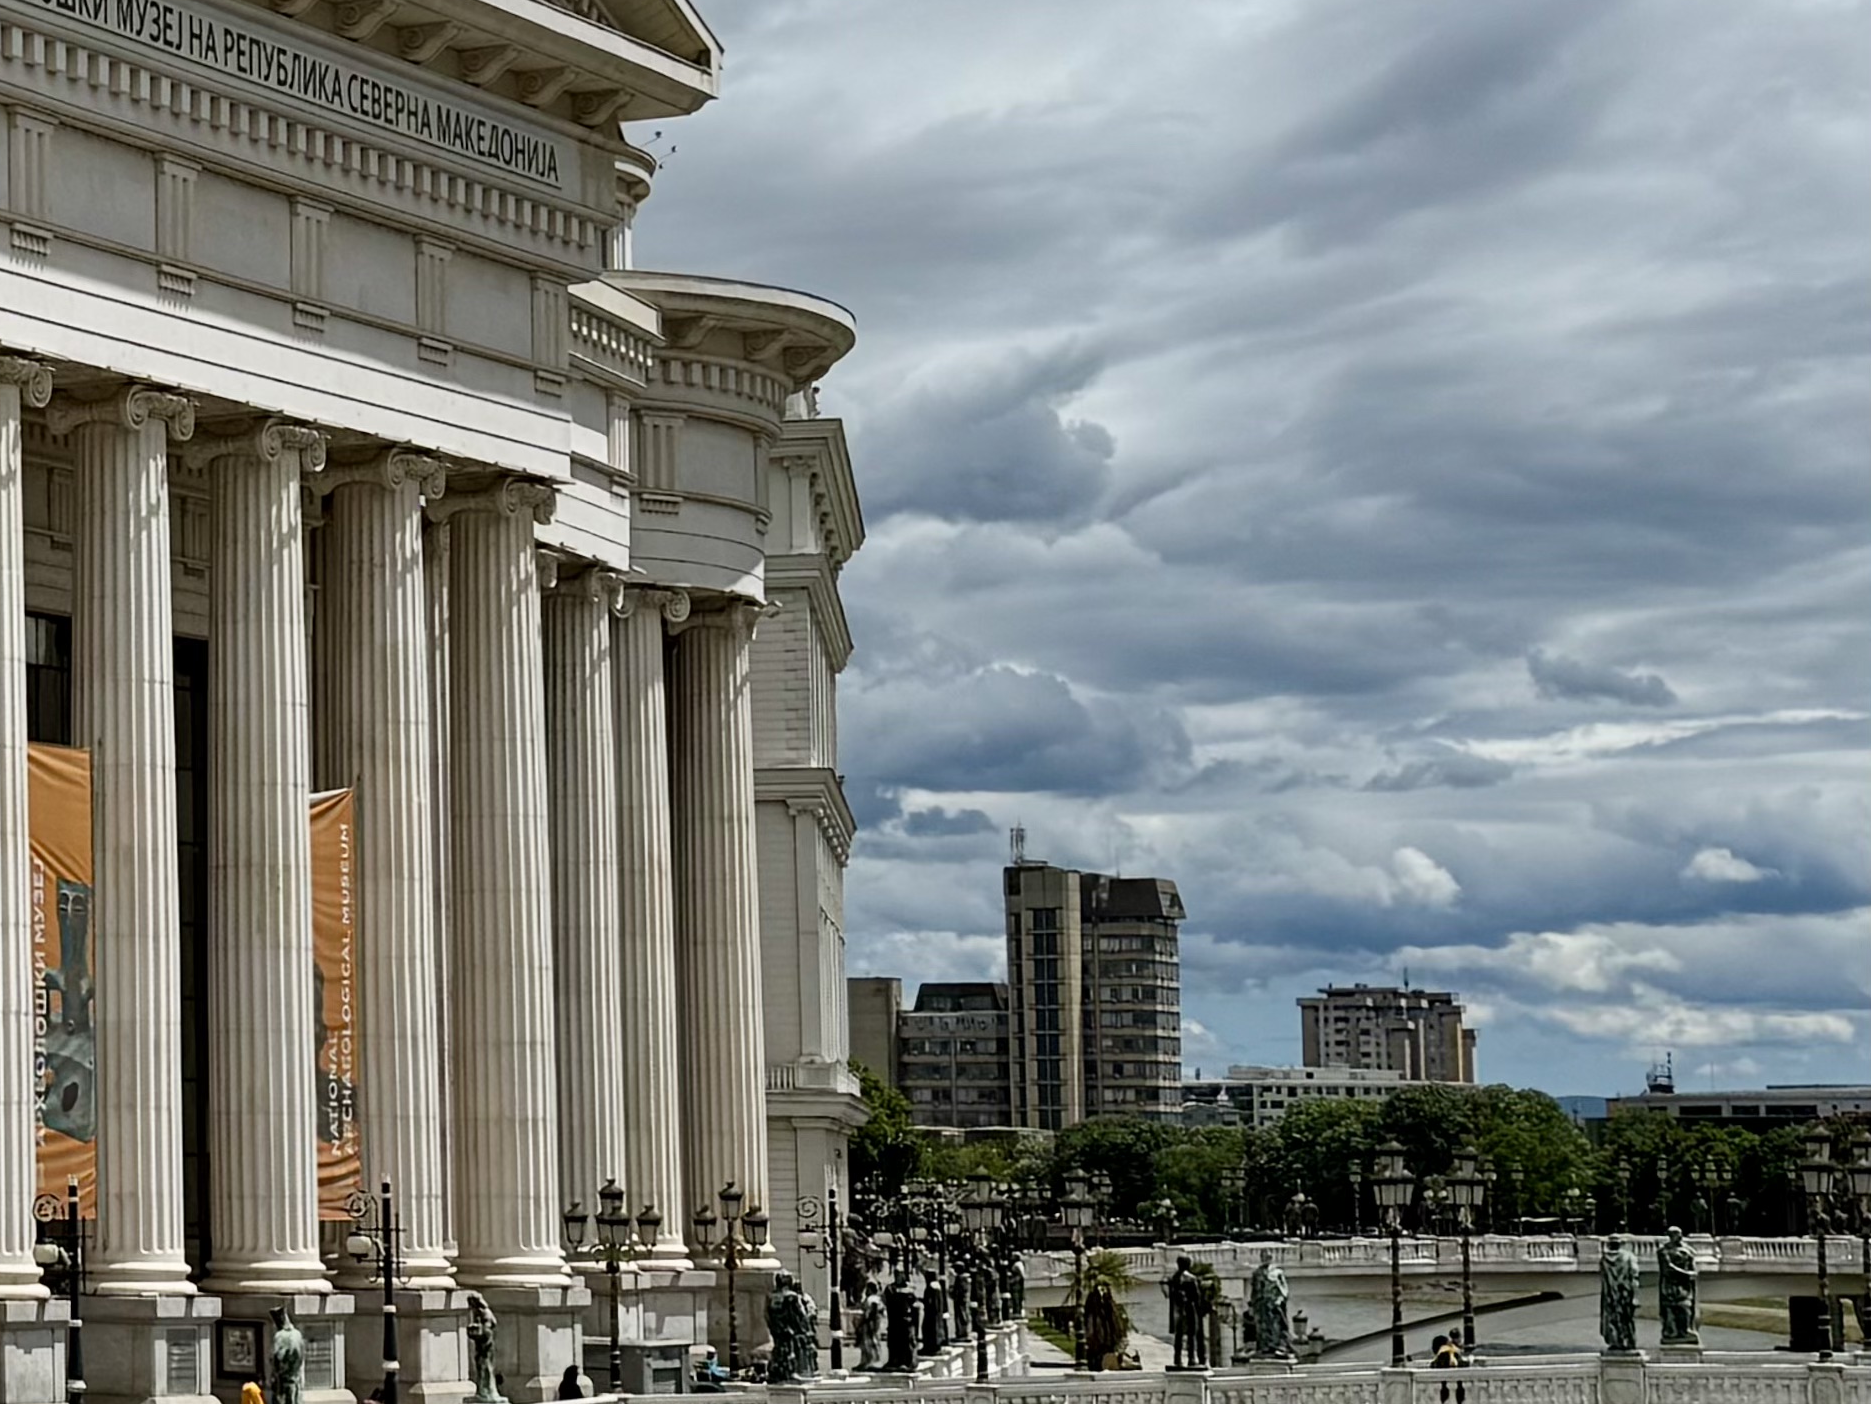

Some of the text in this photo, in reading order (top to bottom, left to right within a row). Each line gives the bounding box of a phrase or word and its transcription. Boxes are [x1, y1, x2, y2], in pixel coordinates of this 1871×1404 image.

[189, 14, 218, 64] НА
[223, 27, 344, 108] РЕПУБЛИКА
[348, 74, 432, 139] СЕВЕРНА
[436, 104, 559, 182] МАКЕДОНИЈА
[340, 823, 350, 925] MUSEUM
[328, 1030, 342, 1157] NATIONAL
